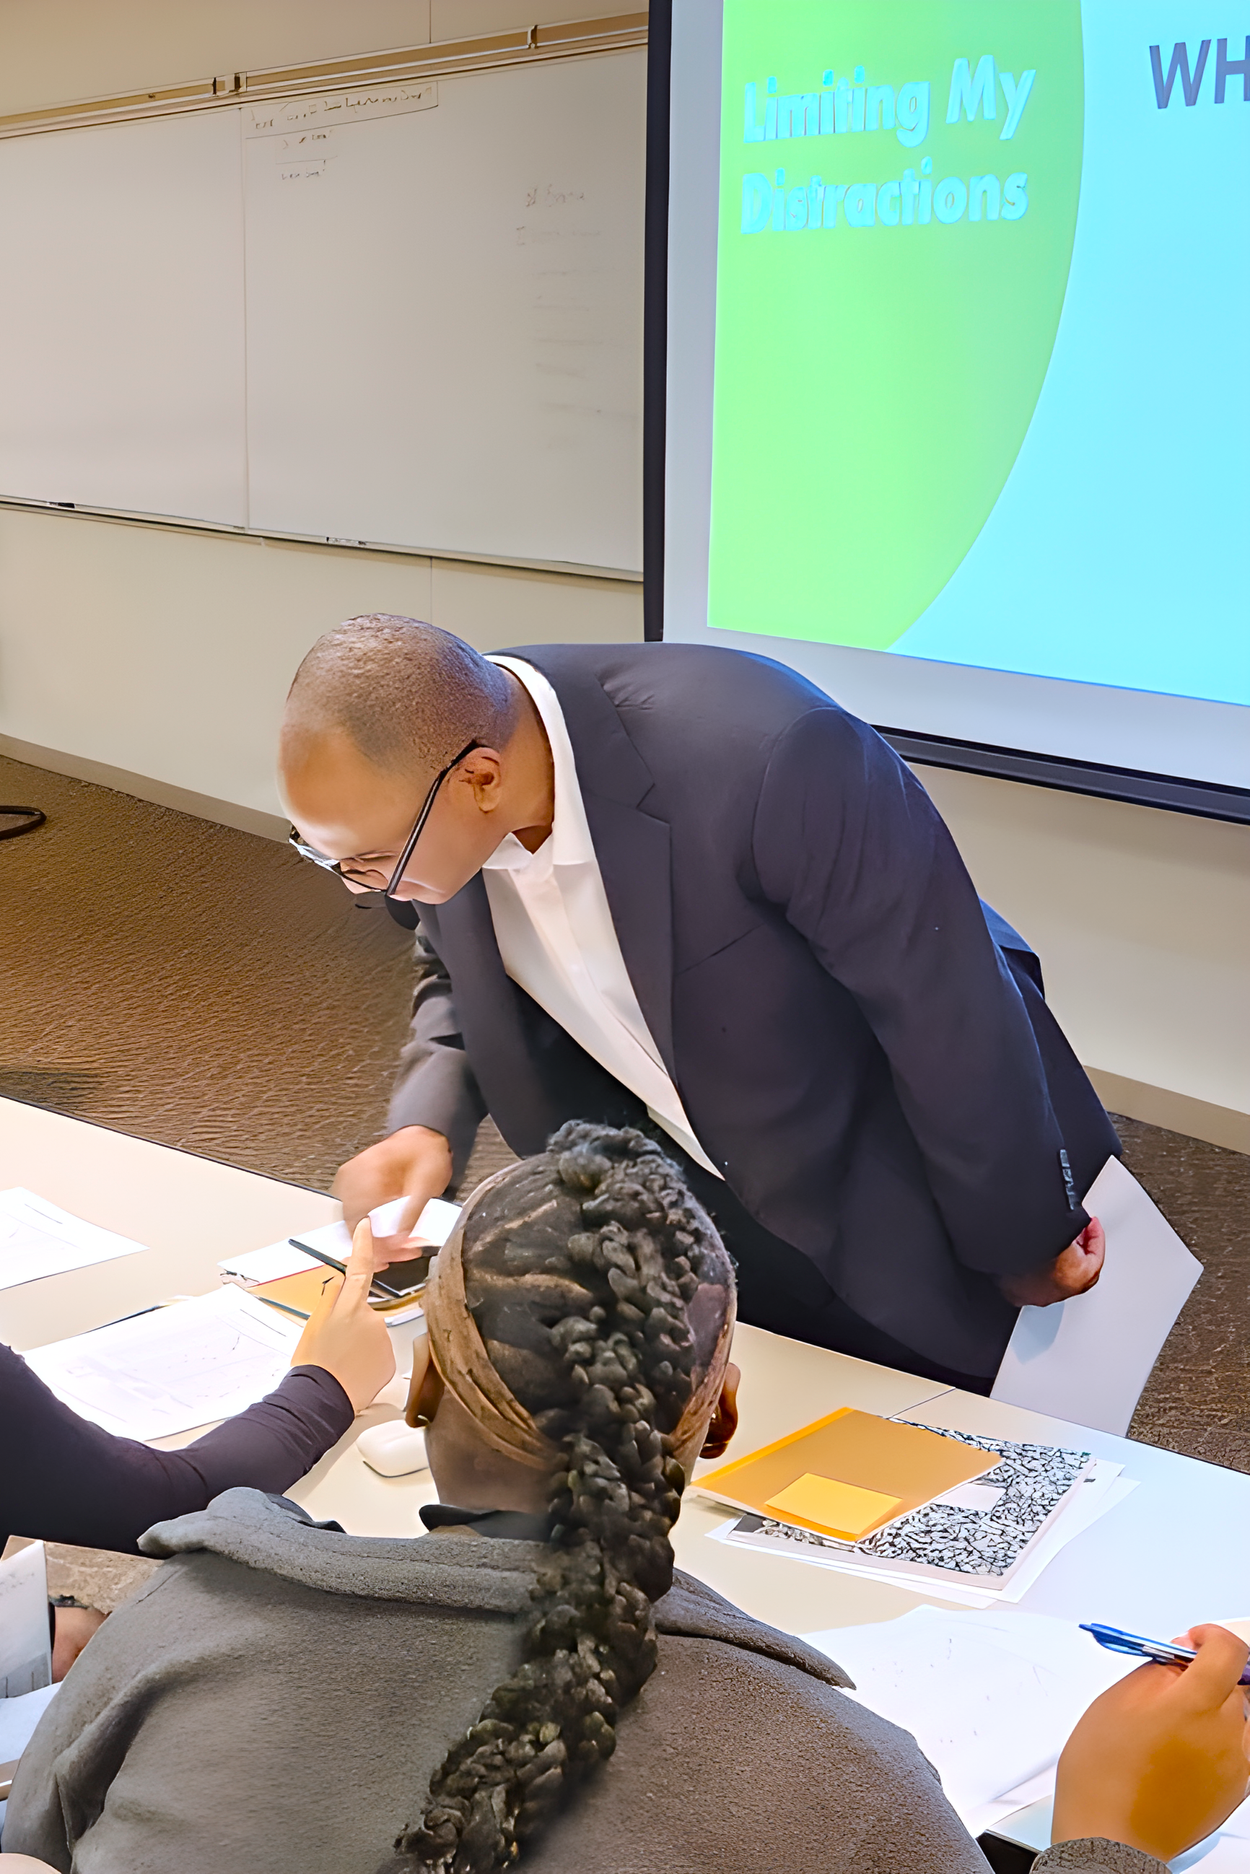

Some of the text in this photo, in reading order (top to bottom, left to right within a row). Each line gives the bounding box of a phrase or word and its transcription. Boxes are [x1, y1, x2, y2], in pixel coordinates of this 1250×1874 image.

[744, 54, 1037, 148] Limiting My
[740, 156, 1030, 235] Distractions
